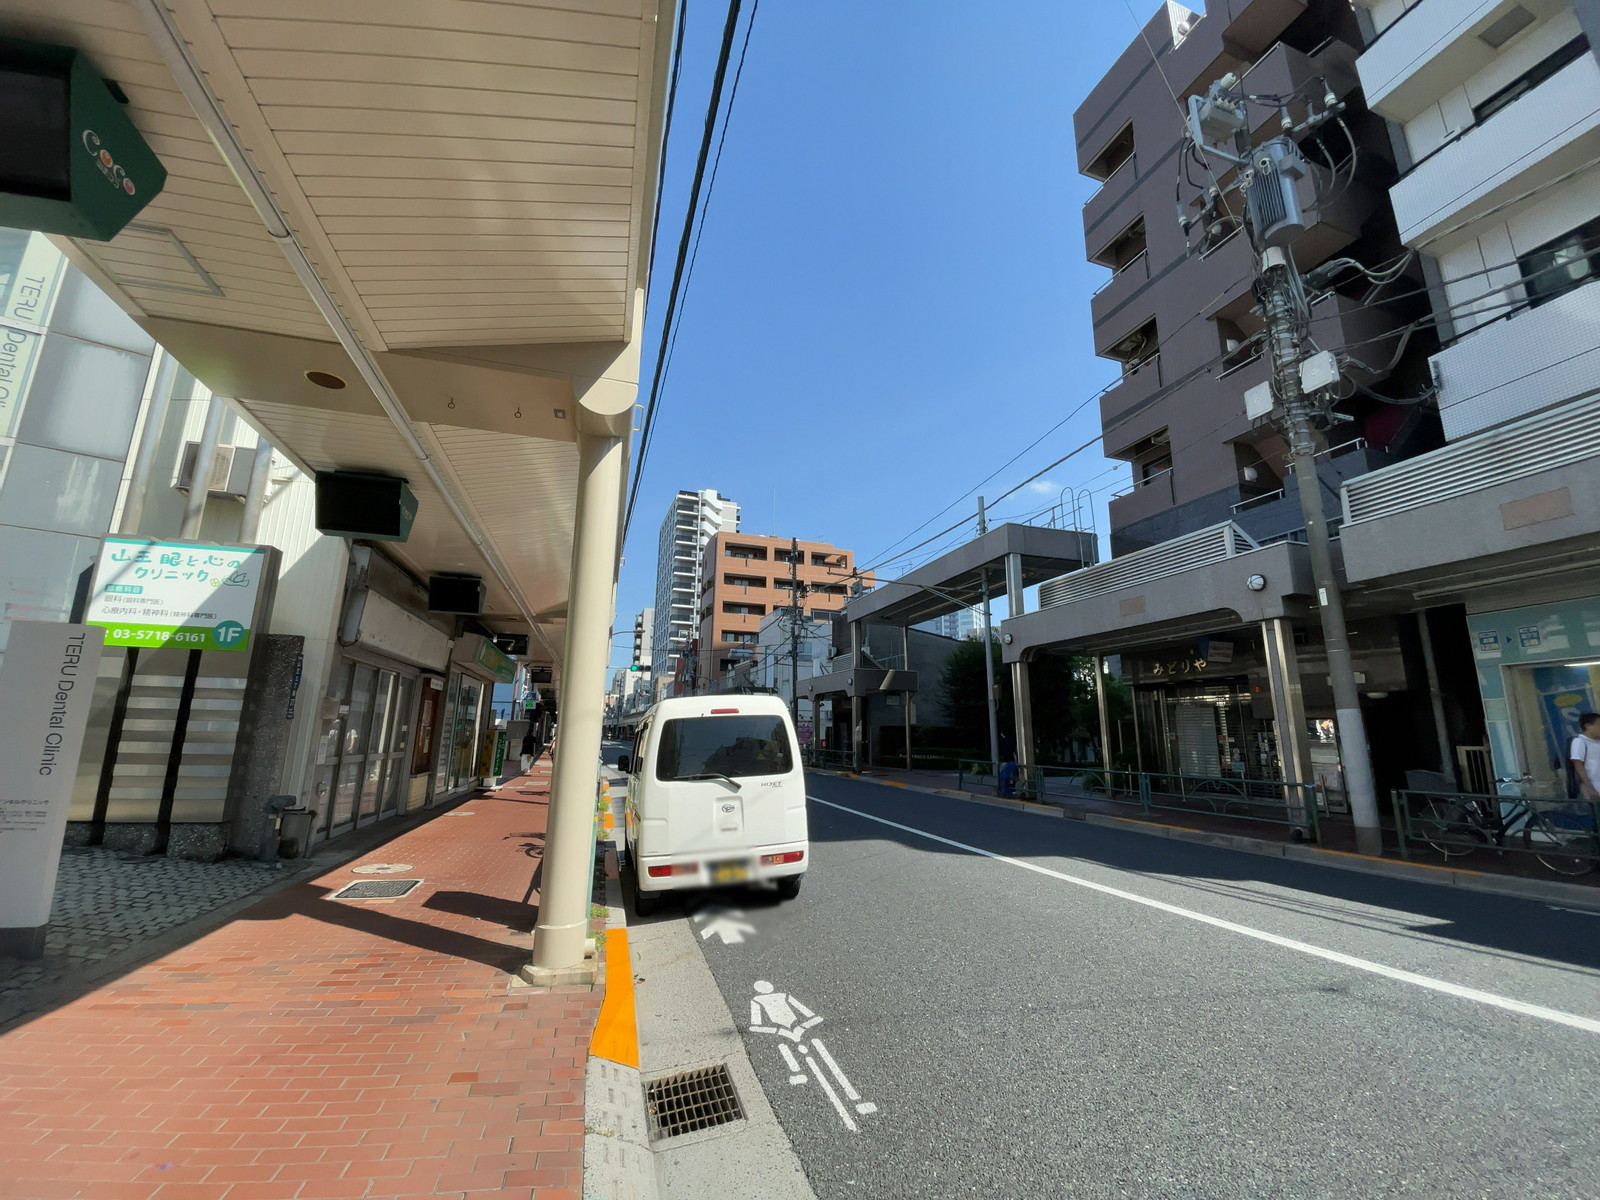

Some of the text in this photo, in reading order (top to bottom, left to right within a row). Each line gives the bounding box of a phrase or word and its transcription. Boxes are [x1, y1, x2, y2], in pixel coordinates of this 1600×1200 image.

[0, 276, 46, 383] TERU Dental
[111, 548, 241, 569] 山王眼と心の
[134, 566, 210, 582] クリニック
[113, 628, 205, 643] 03-5718-6161
[217, 626, 241, 643] 1F
[1152, 657, 1207, 676] みどりや
[39, 632, 86, 776] TERU Dental Clinic
